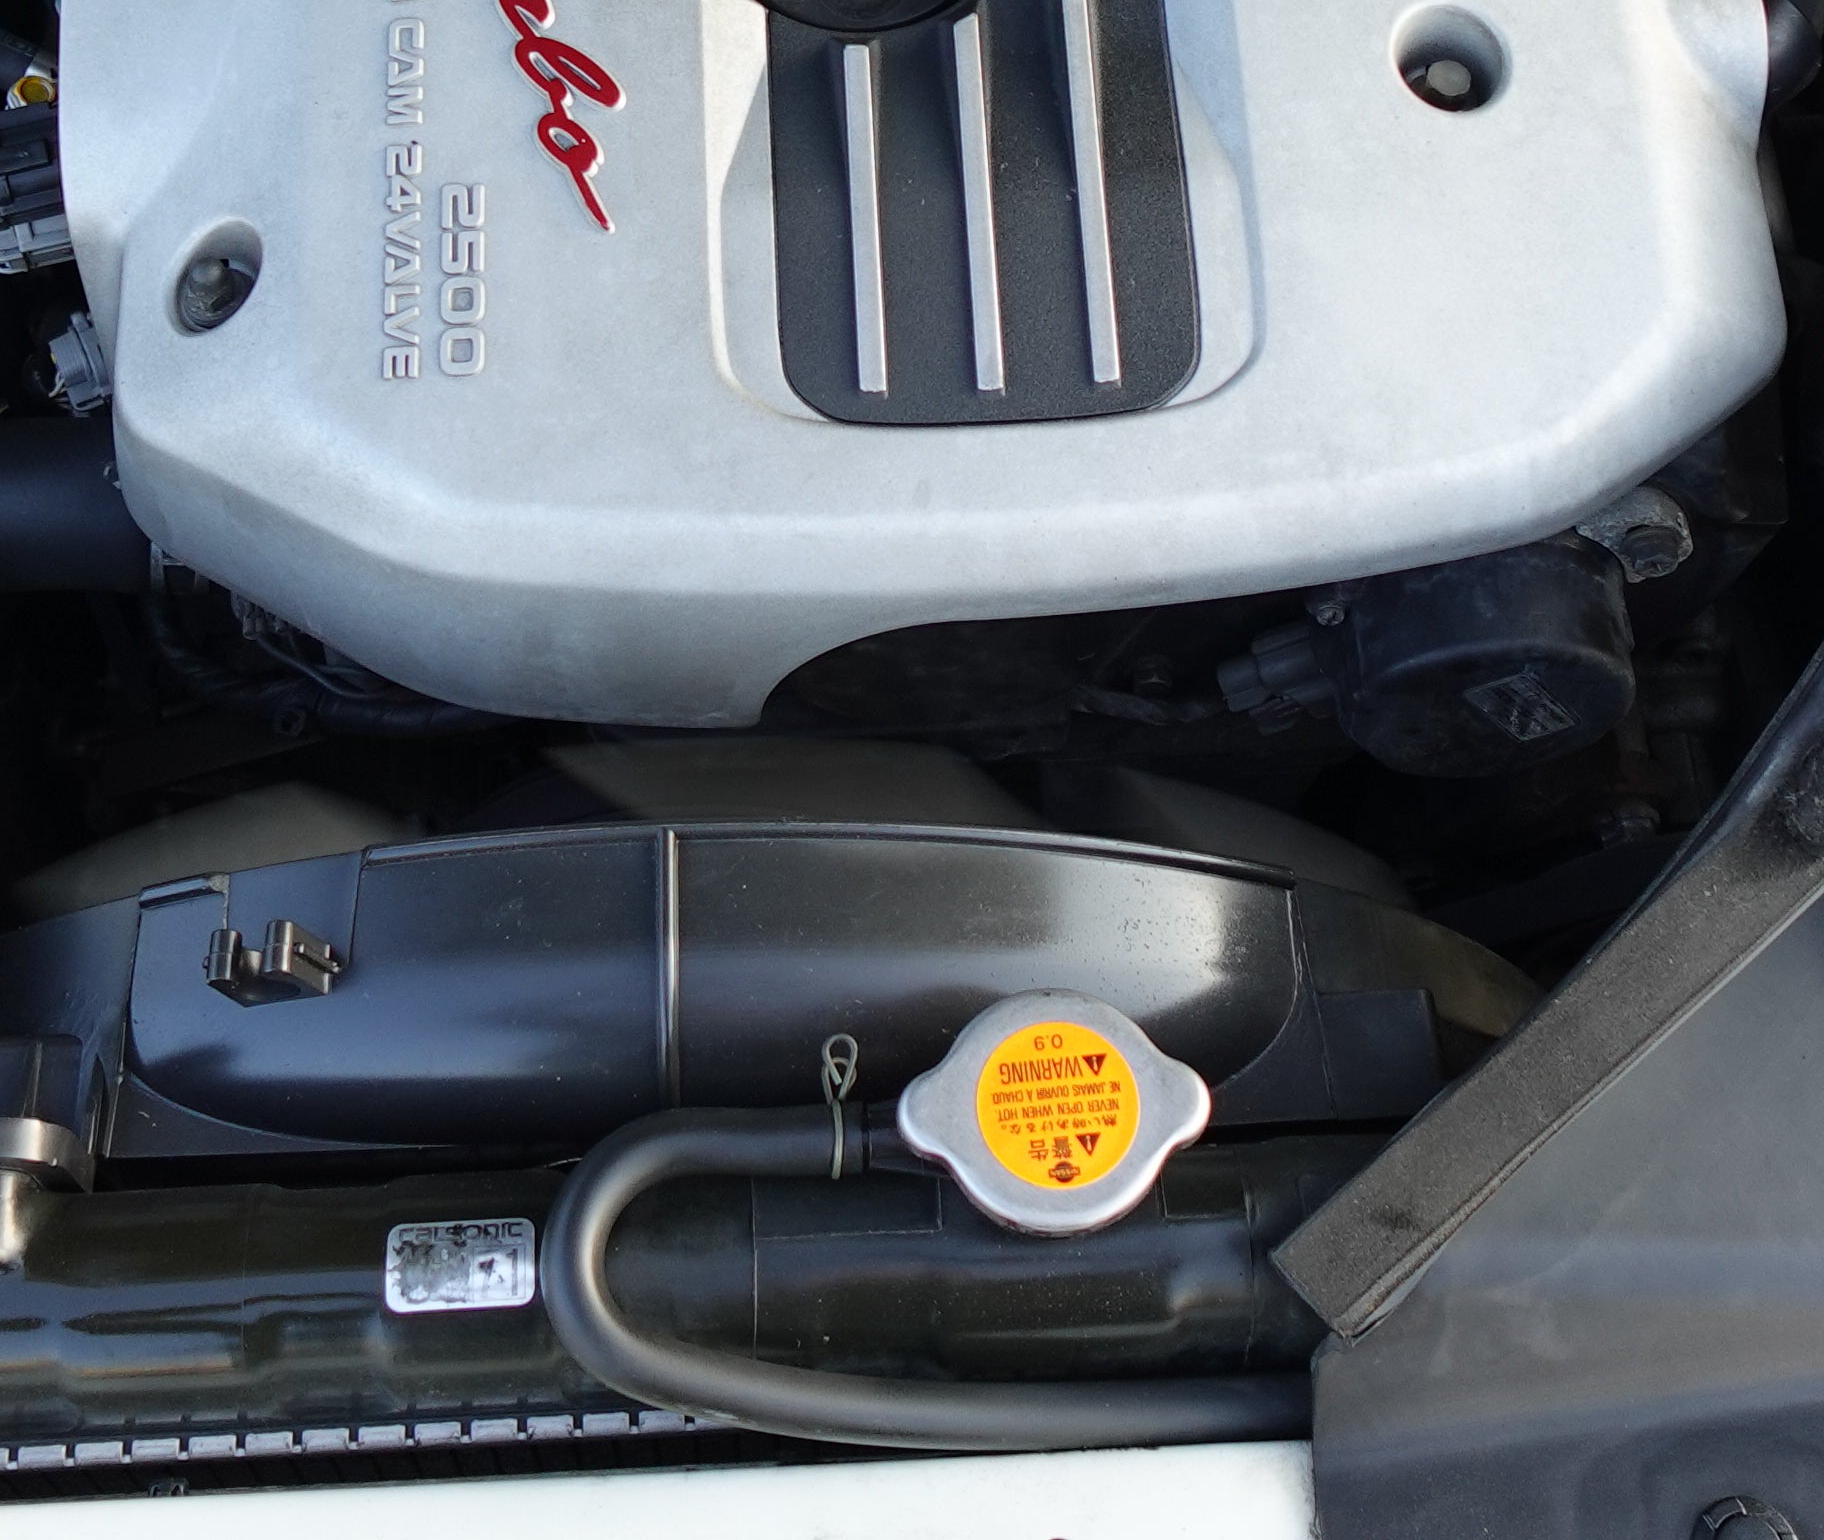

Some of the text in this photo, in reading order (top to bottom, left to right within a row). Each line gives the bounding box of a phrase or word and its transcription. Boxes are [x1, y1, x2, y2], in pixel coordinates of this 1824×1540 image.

[386, 17, 428, 127] CAM
[381, 140, 425, 382] 24VALVE
[439, 182, 486, 377] 2500
[1033, 1033, 1063, 1051] 0.9
[999, 1055, 1082, 1084] WARNING
[1026, 1089, 1033, 1103] À
[1072, 1082, 1106, 1096] JAMAIS
[1109, 1080, 1121, 1093] NE
[991, 1091, 1024, 1105] CHAUD.
[995, 1098, 1119, 1122] NEVER OPEN WHEN HOT.
[1000, 1114, 1117, 1135] 熱い時あけるな。
[1028, 1136, 1072, 1160] 警告
